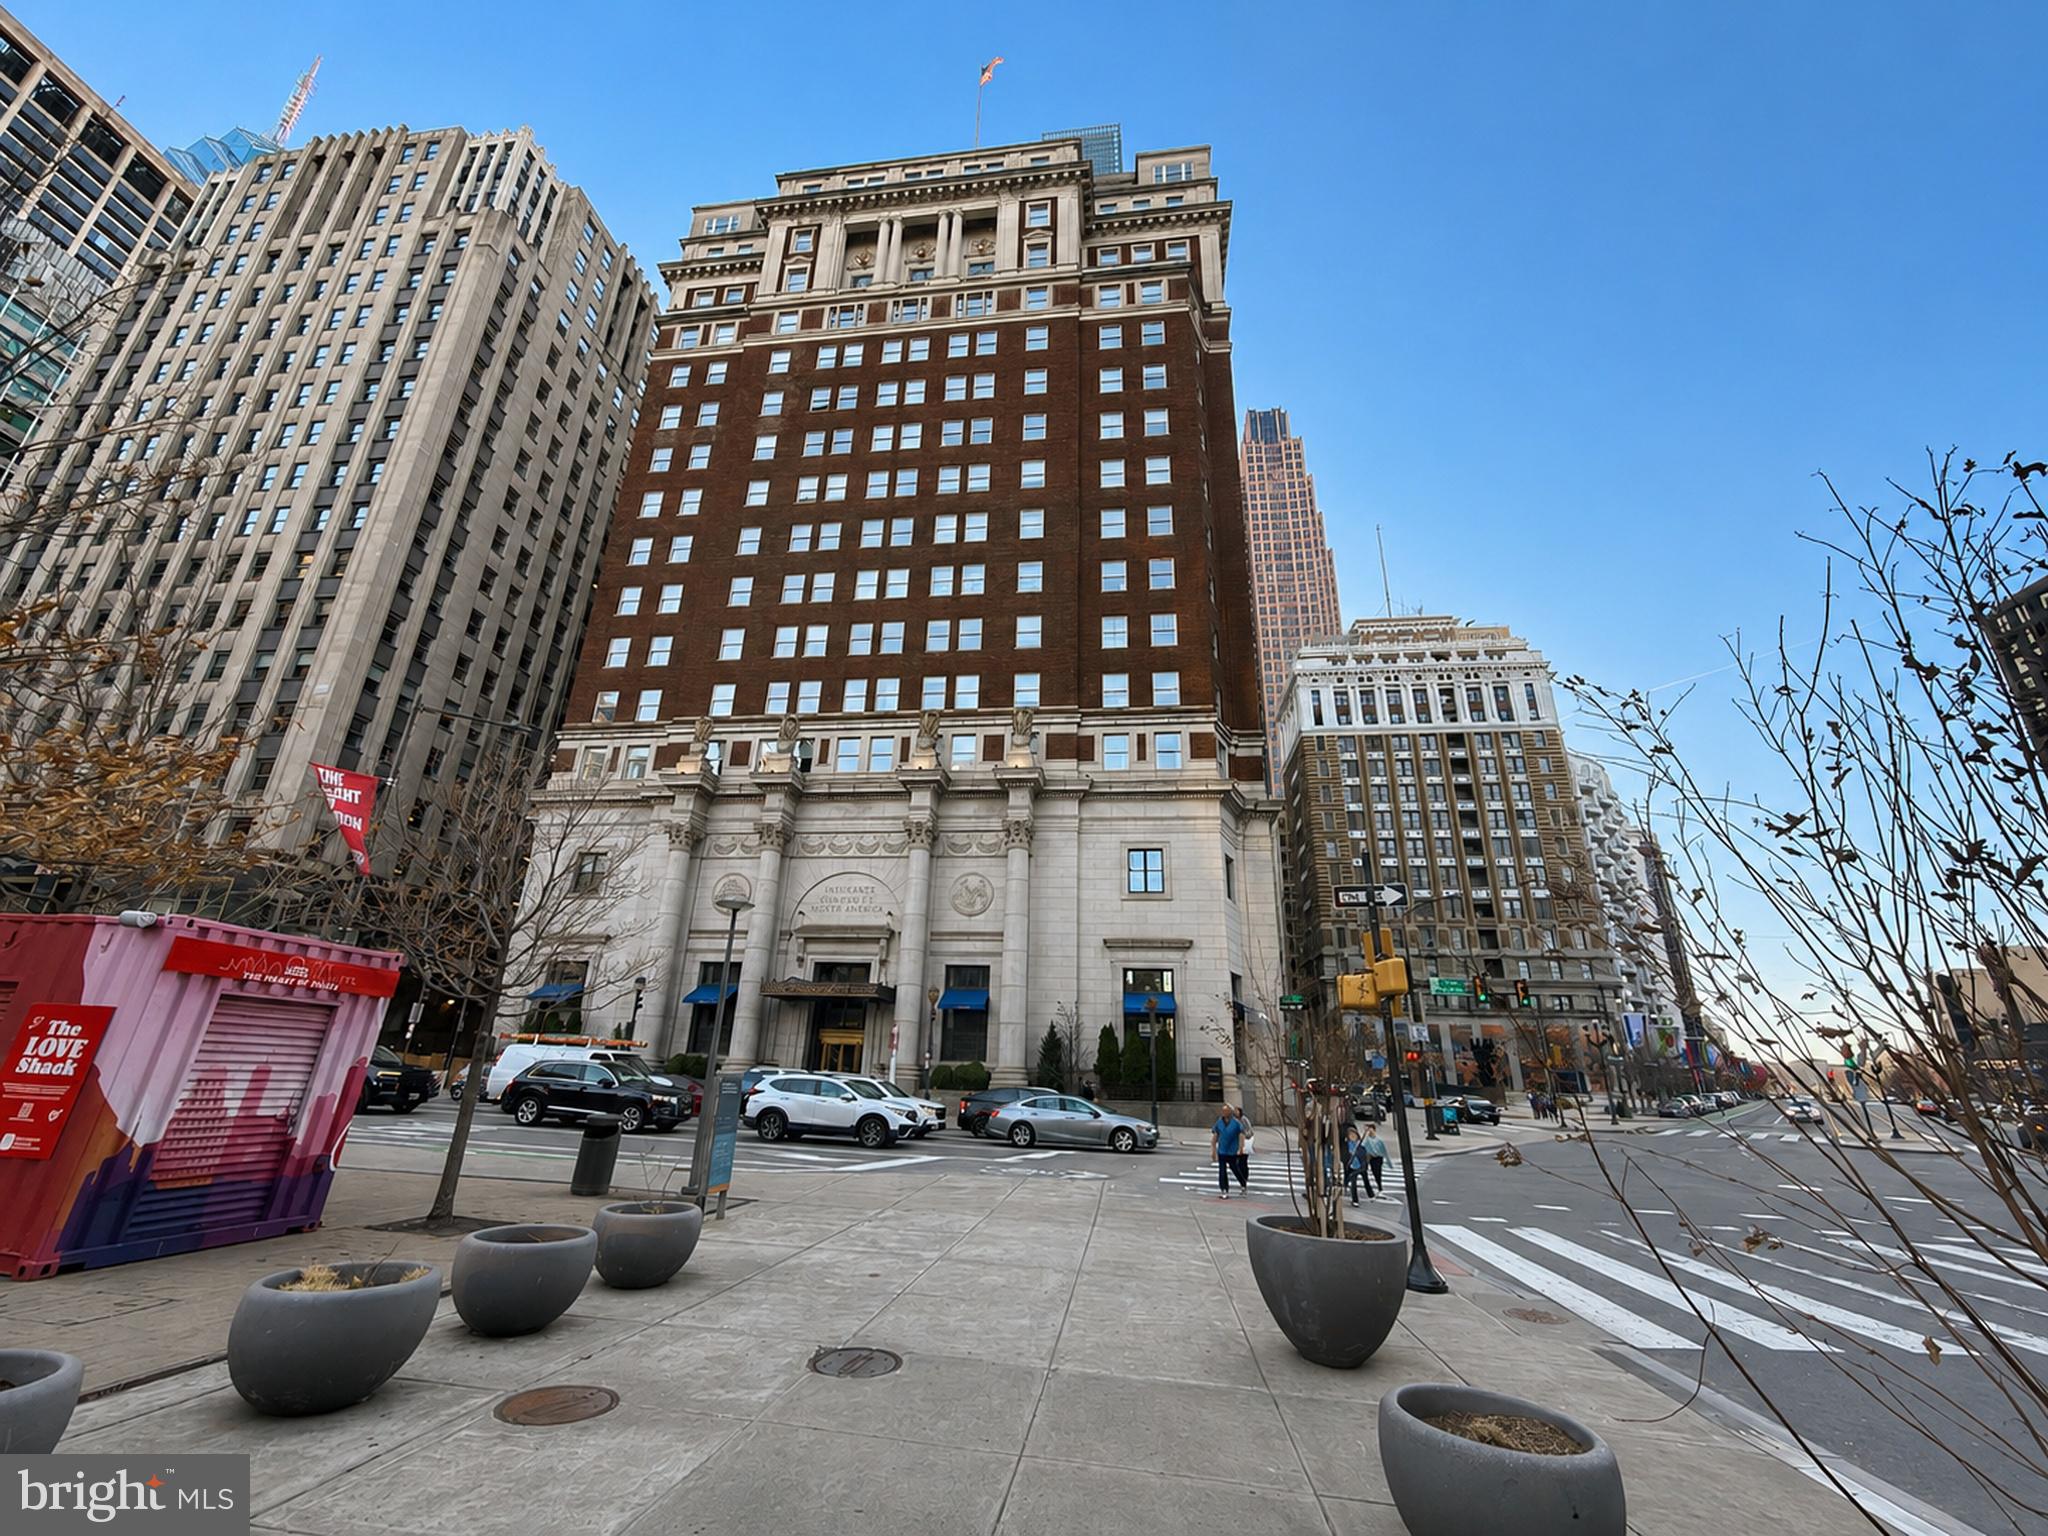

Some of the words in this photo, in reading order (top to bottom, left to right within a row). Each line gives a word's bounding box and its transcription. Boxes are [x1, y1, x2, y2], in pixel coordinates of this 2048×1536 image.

[47, 1019, 82, 1036] The
[23, 1036, 89, 1059] LOVE
[15, 1057, 78, 1076] Shack
